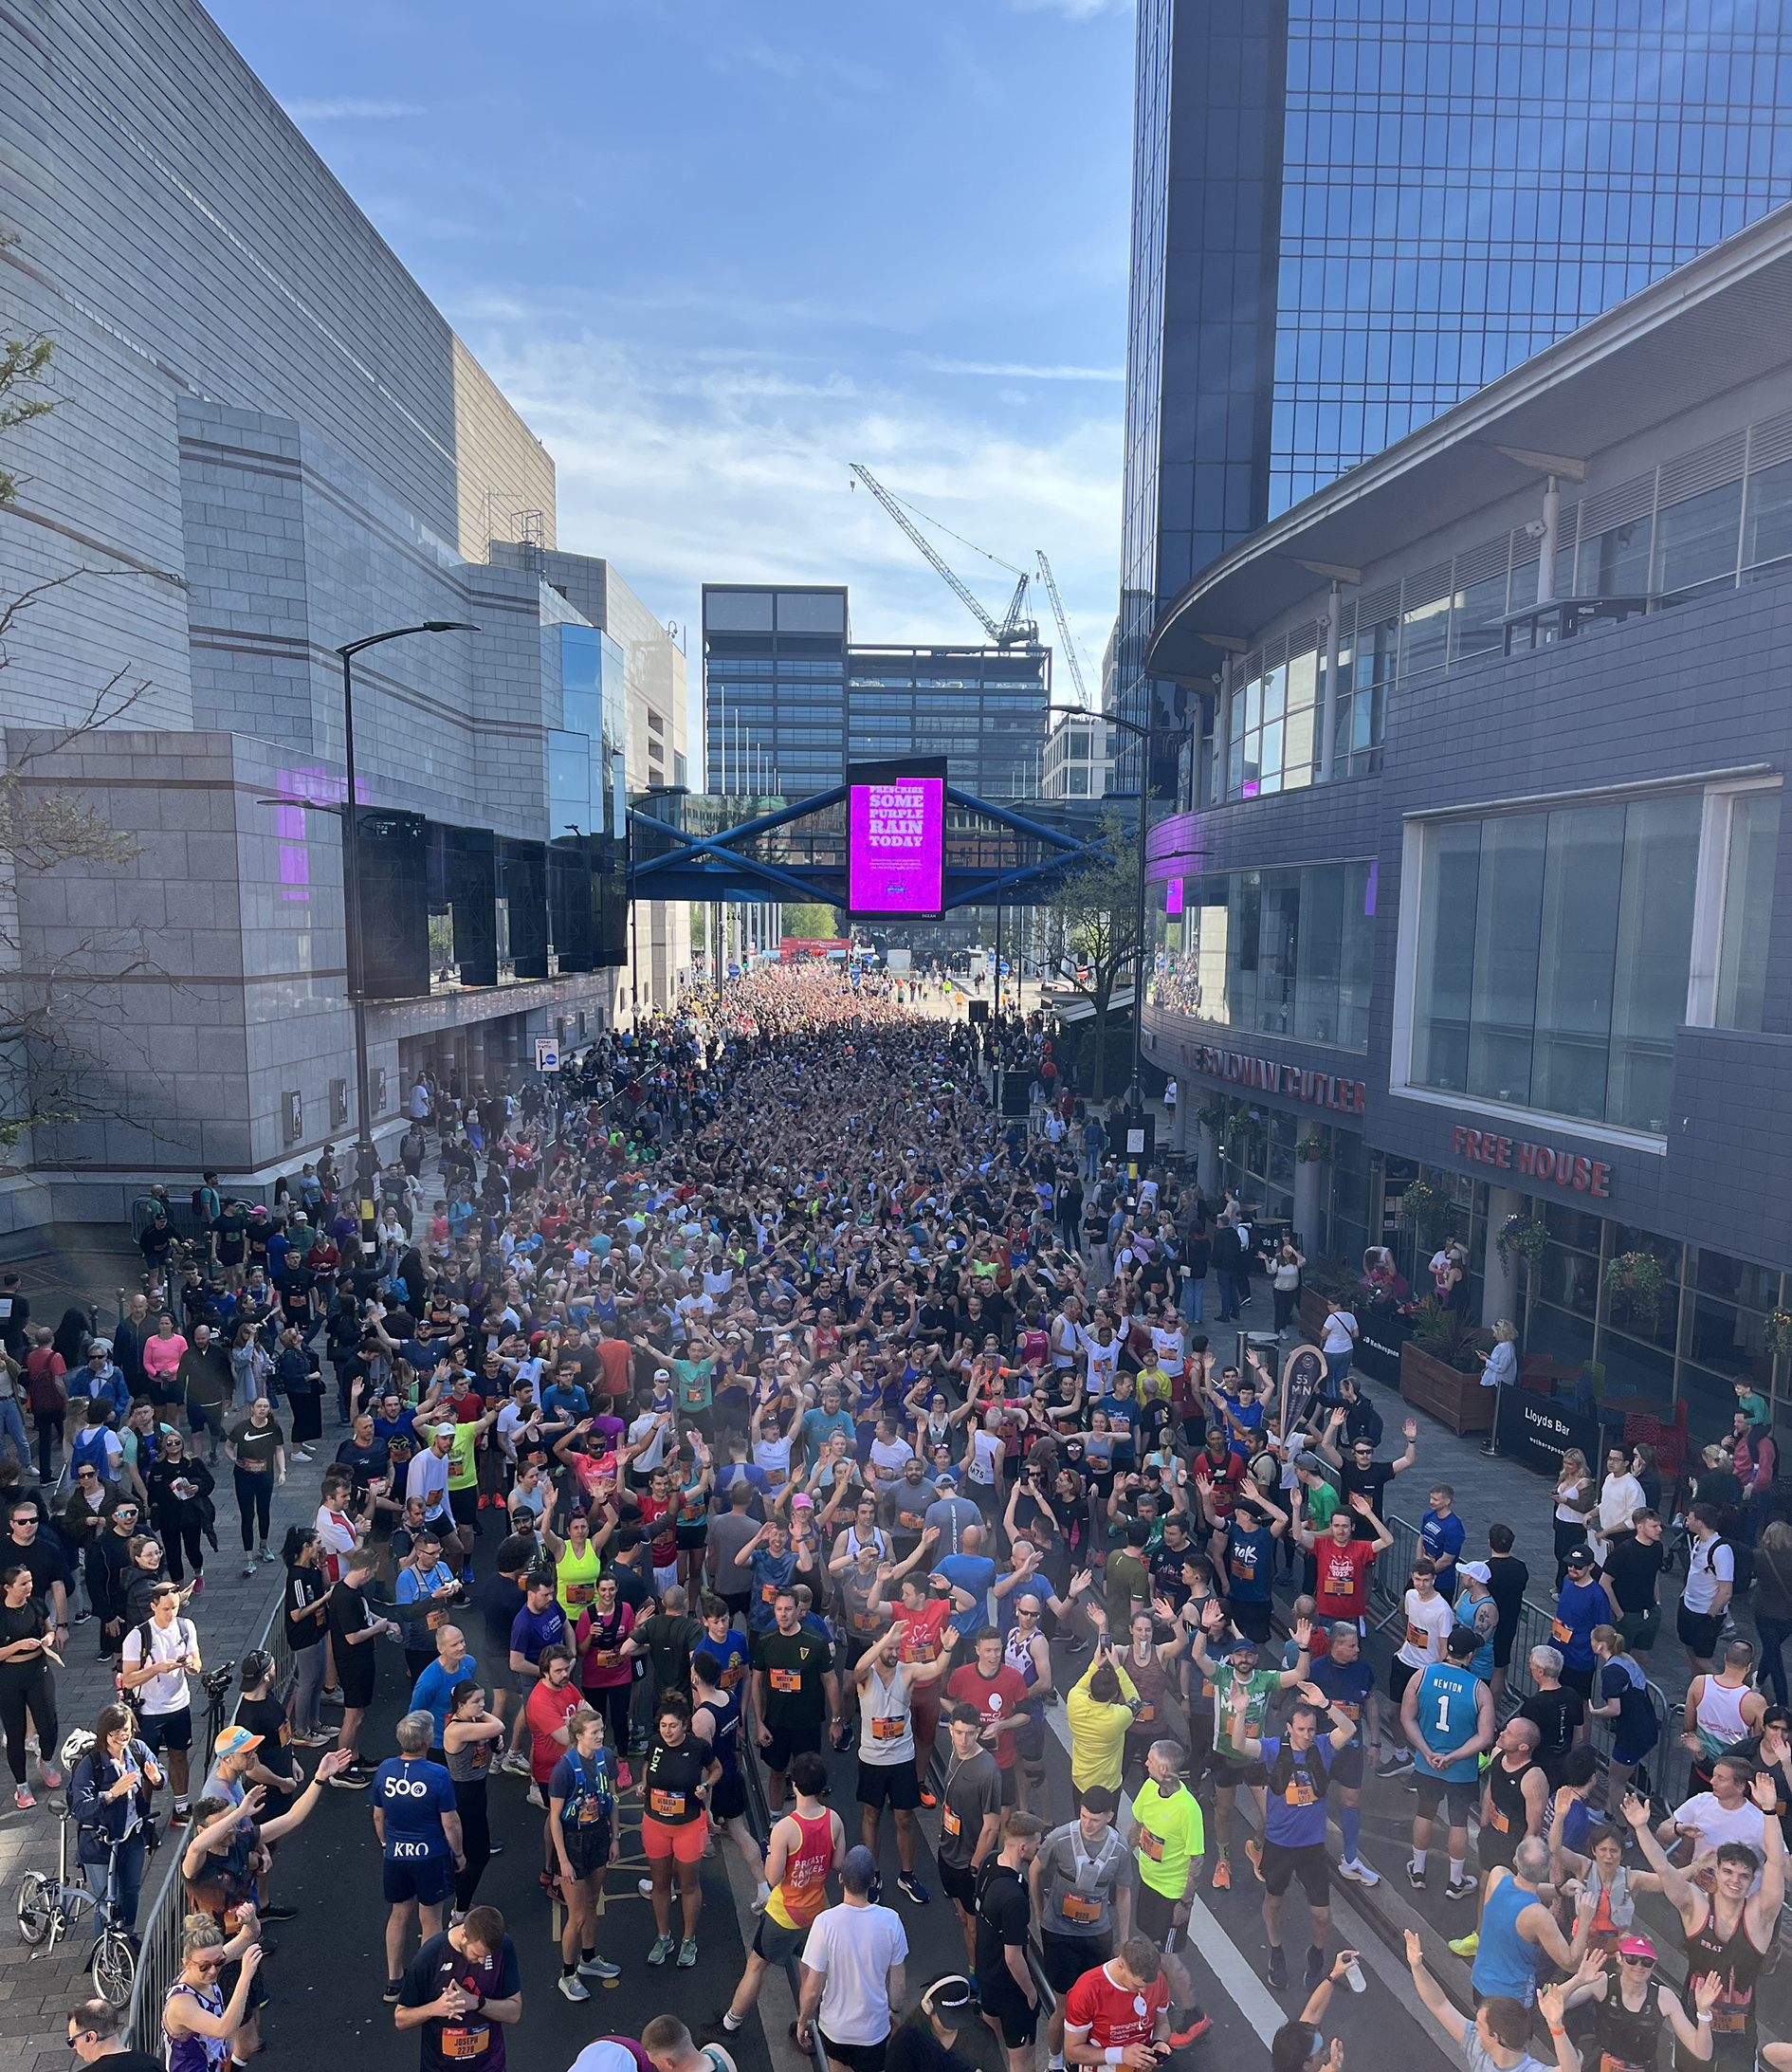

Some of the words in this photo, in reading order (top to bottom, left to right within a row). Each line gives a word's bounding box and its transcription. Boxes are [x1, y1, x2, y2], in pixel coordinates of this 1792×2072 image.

[869, 795, 924, 807] SOME
[869, 809, 924, 818] PURPLE
[869, 820, 923, 834] RAIN
[869, 836, 923, 846] TODAY
[1282, 1064, 1365, 1115] CUTLER
[1453, 1126, 1512, 1168] FREE
[1519, 1142, 1611, 1197] HOUSE
[1525, 1407, 1553, 1428] Lloyds
[1555, 1420, 1570, 1436] Bar
[970, 1466, 984, 1479] M75
[1234, 1545, 1258, 1563] 10K
[1433, 1678, 1463, 1693] NEWTON
[1436, 1695, 1450, 1732] 1
[649, 1747, 663, 1772] LDN
[384, 1777, 427, 1797] 500
[393, 1842, 429, 1857] KRO
[794, 1854, 826, 1870] BREAST
[792, 1865, 824, 1879] CANCER
[791, 1876, 810, 1888] NOW
[1701, 1939, 1723, 1952] BRAT
[1110, 2021, 1141, 2031] Birmingham
[454, 2036, 478, 2046] JOSEPH
